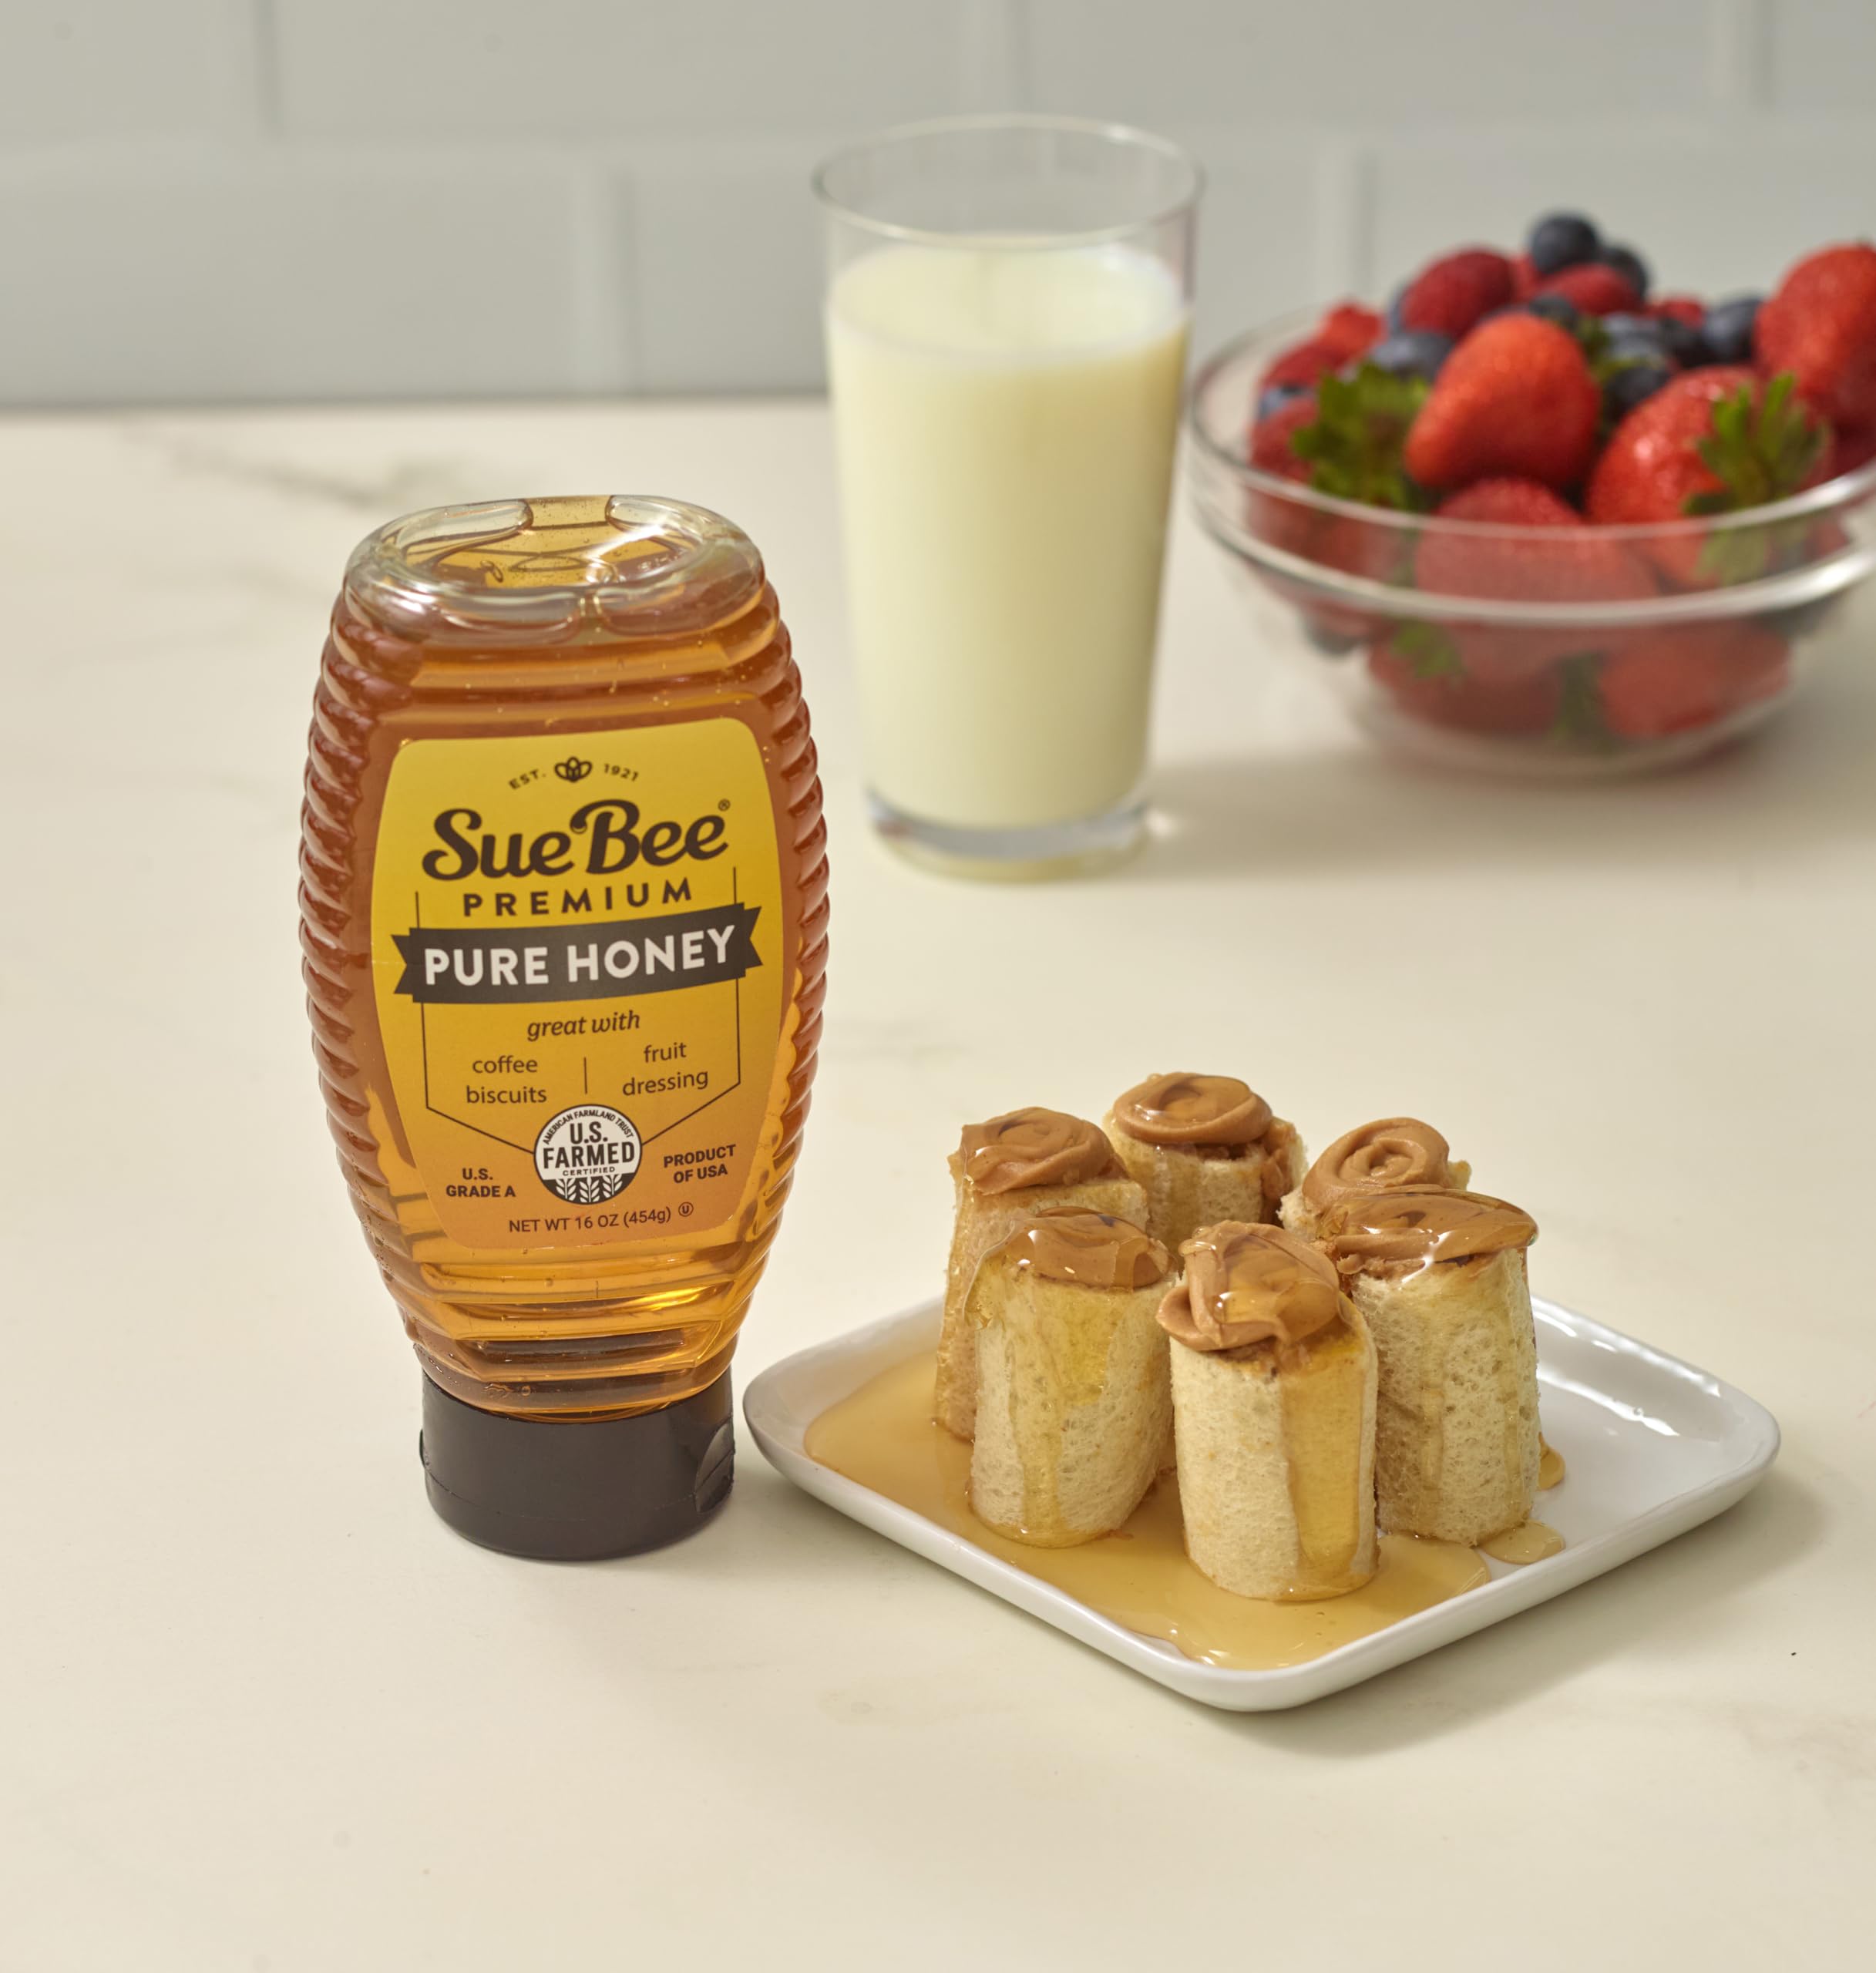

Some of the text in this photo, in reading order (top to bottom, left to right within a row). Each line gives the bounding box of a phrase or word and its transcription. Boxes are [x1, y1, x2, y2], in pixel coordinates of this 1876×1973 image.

[509, 768, 546, 790] EST.
[603, 764, 638, 781] 1921
[422, 808, 575, 881] Sue
[463, 877, 691, 916] PREMIUM
[425, 925, 735, 986] PURE HONEY
[527, 1010, 640, 1041] great with
[472, 1055, 538, 1074] coffee
[644, 1042, 687, 1064] fruit
[466, 1085, 547, 1104] biscuits
[622, 1069, 708, 1097] dressing
[543, 1109, 634, 1144] AMERICAN FARMLAND TRUST
[570, 1121, 608, 1144] U.S.
[543, 1141, 635, 1169] FARMED
[664, 1144, 736, 1168] PRODUCT
[462, 1168, 493, 1180] U.S.
[563, 1166, 615, 1176] CERTIFIED
[674, 1164, 728, 1184] OF USA
[446, 1185, 516, 1197] GRADE A
[509, 1207, 671, 1232] NET WT 16 OZ (454g)
